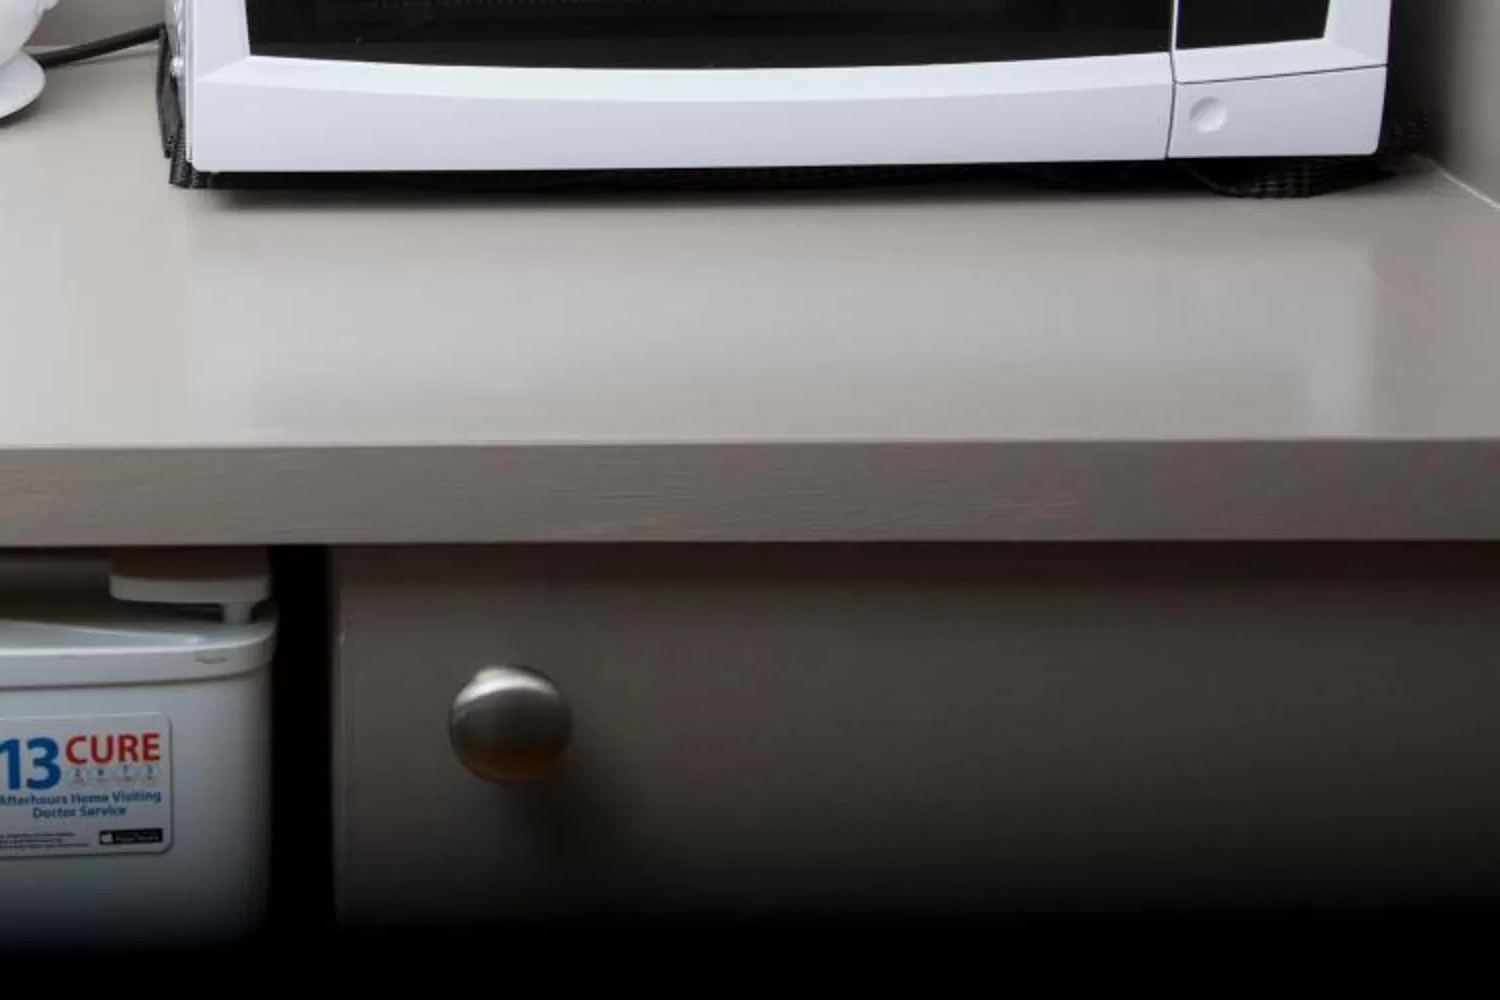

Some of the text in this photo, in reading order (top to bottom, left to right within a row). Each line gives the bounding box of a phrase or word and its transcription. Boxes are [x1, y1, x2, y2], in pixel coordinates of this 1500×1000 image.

[65, 732, 162, 765] CURE
[70, 792, 109, 804] Home
[112, 790, 162, 804] Visiting
[32, 805, 127, 819] Doctor Service
